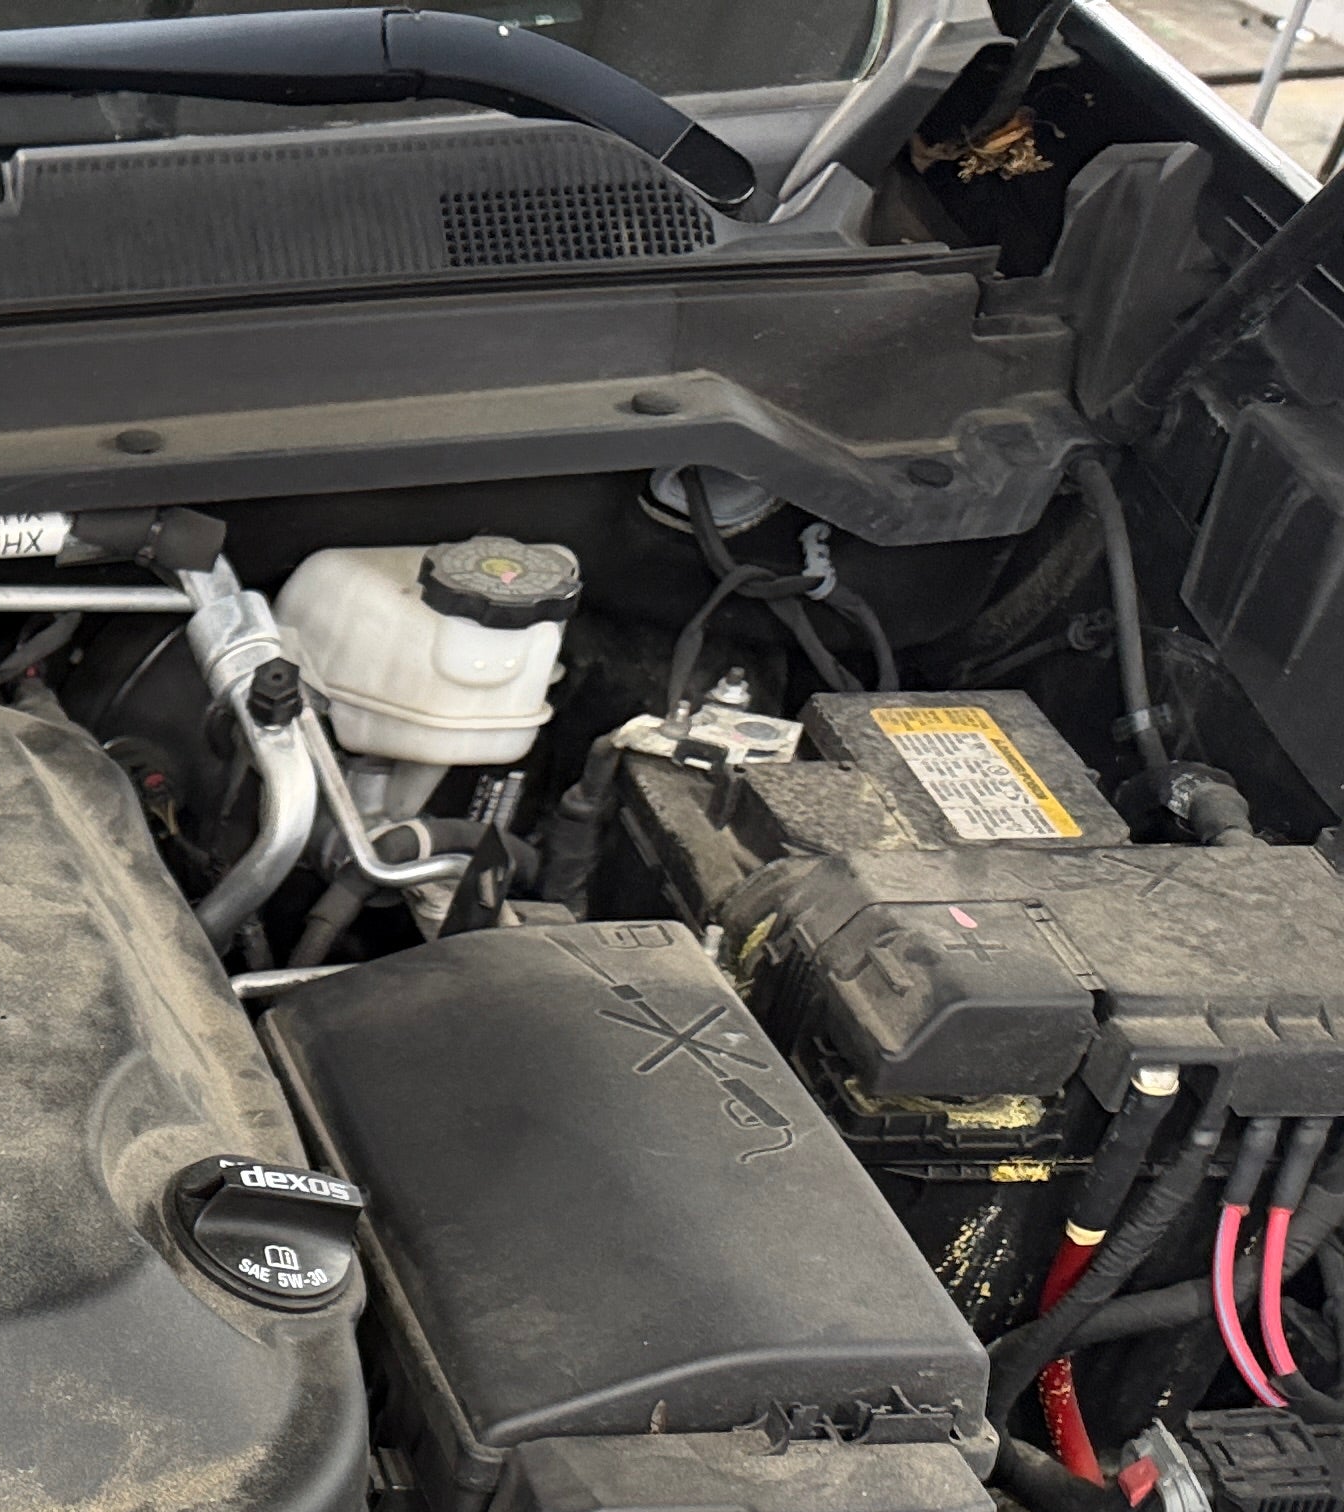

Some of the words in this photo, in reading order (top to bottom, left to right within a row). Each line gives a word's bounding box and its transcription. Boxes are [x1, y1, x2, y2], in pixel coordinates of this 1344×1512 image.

[240, 1165, 349, 1200] dexos
[238, 1258, 271, 1283] SAE
[277, 1267, 328, 1289] 5W-30
